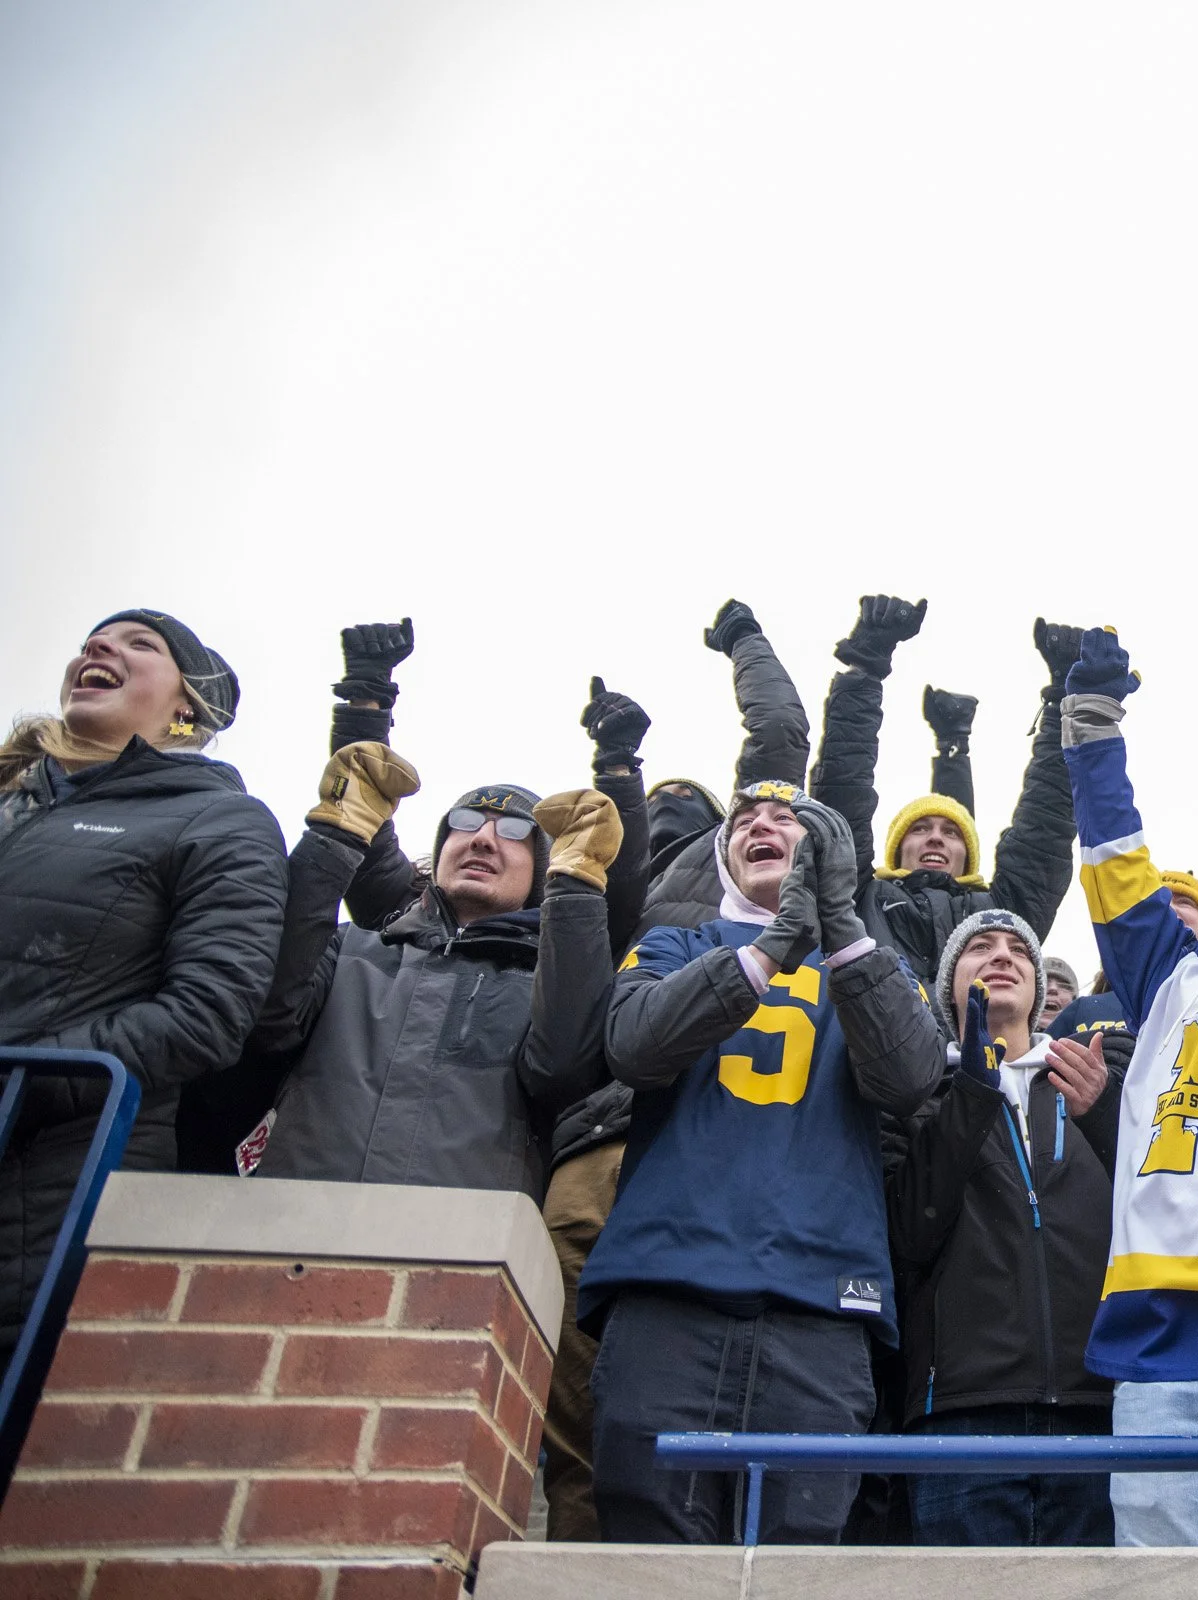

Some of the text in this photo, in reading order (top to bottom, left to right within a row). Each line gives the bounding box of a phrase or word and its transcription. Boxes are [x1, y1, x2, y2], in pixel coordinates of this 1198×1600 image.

[756, 783, 797, 801] M
[979, 912, 1015, 927] M
[1166, 1091, 1185, 1108] AD
